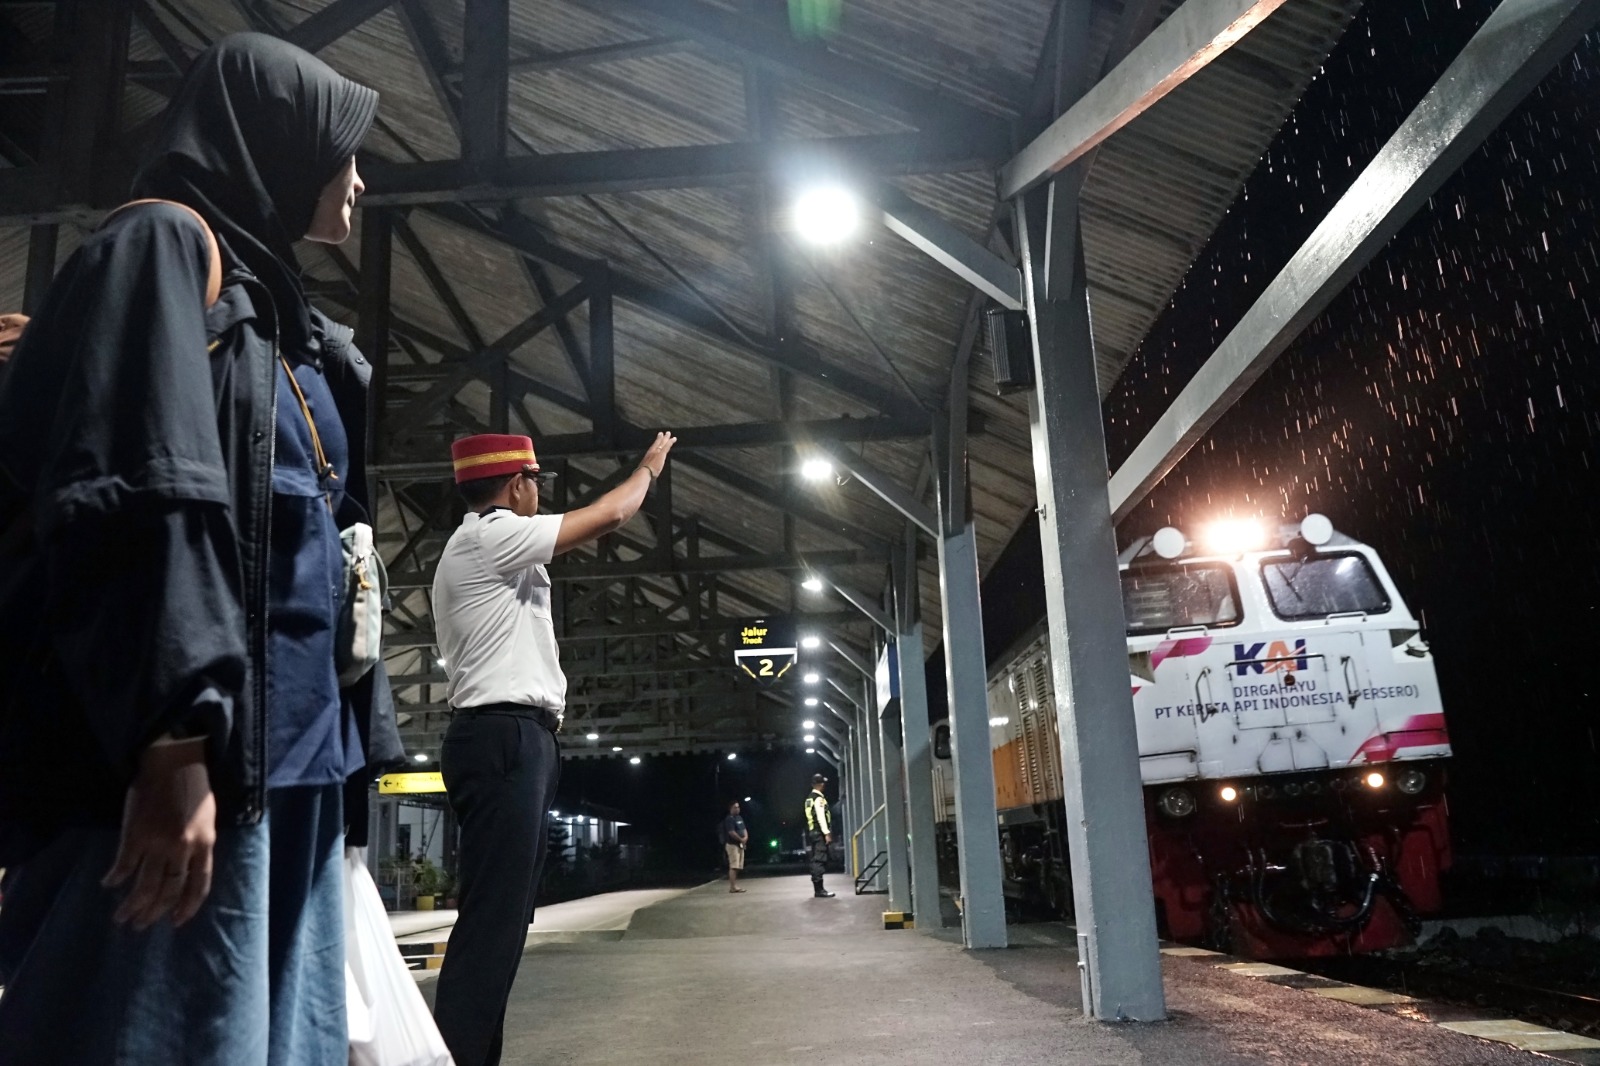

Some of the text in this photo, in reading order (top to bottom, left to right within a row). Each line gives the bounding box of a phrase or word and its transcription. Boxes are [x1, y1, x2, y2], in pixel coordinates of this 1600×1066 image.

[741, 626, 768, 637] Jalur
[1234, 638, 1308, 676] KAI
[759, 658, 774, 676] 2
[1233, 680, 1317, 698] DIRGAHAYU
[1155, 706, 1172, 719] PT
[1234, 698, 1258, 712] API
[1263, 691, 1345, 710] INDONESIA
[1349, 684, 1419, 702] ERSERO)
